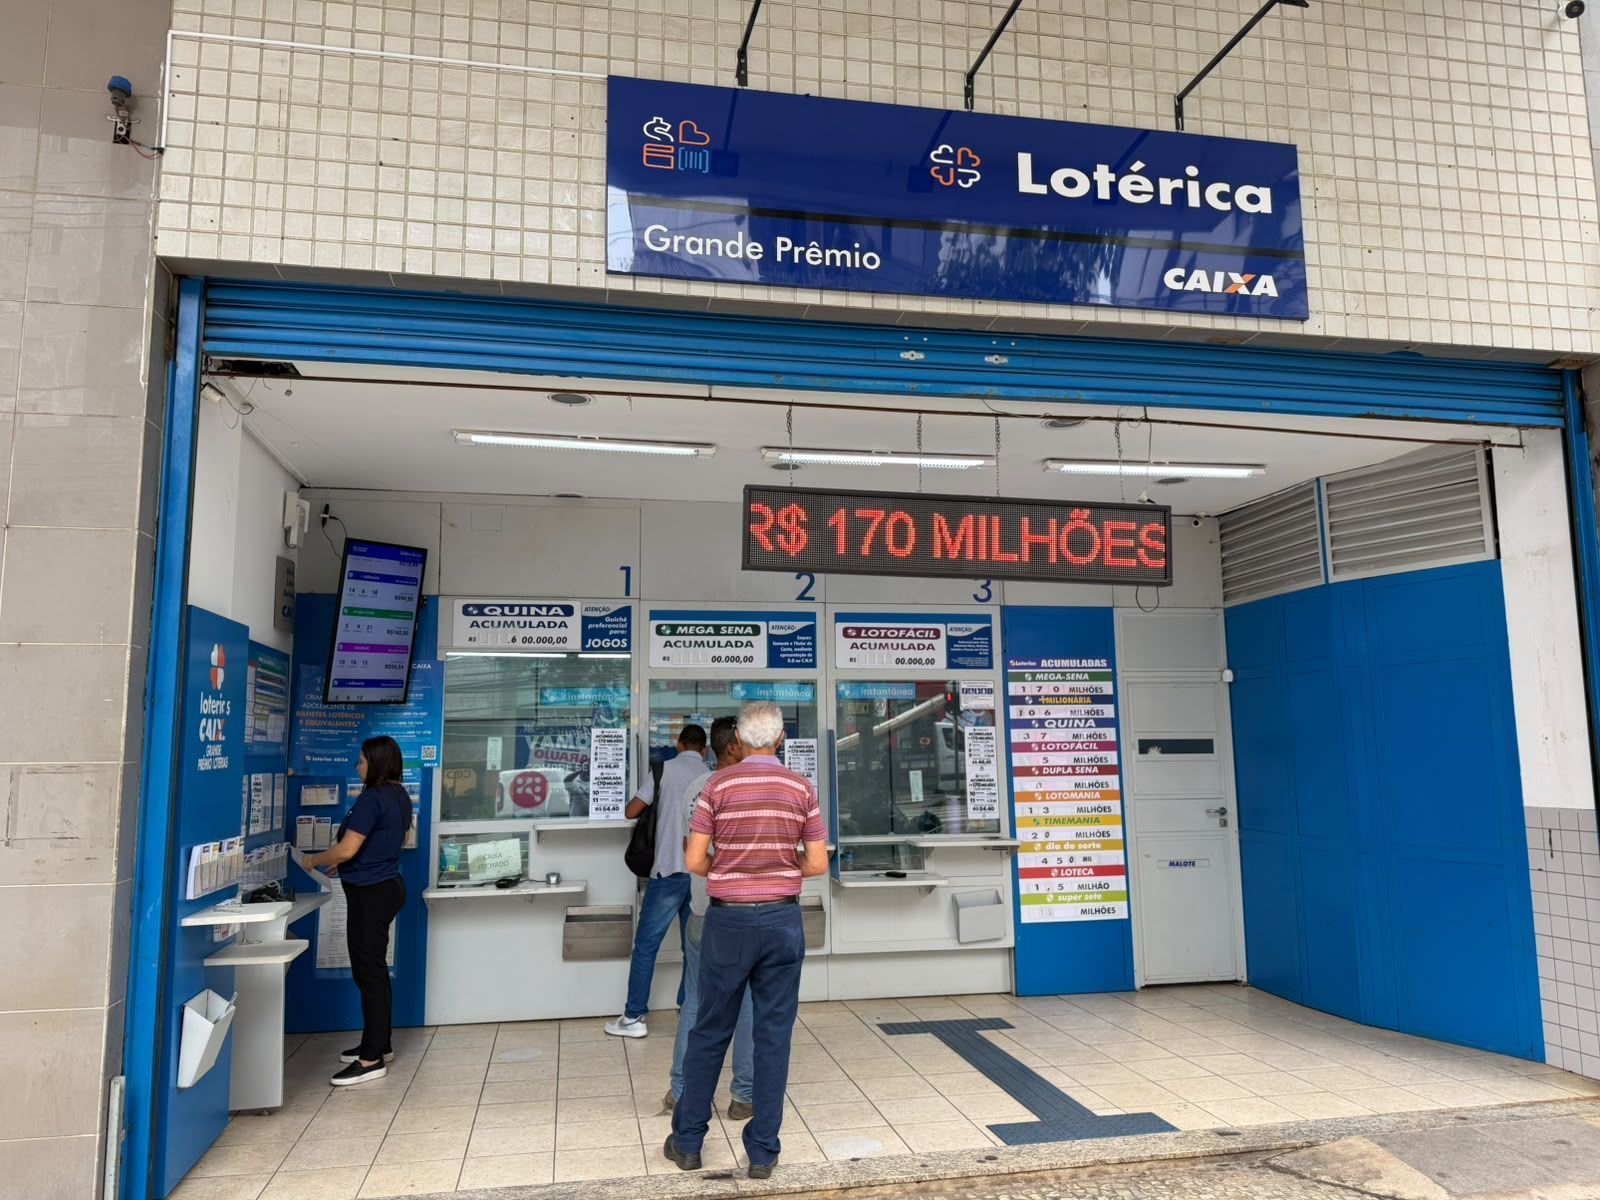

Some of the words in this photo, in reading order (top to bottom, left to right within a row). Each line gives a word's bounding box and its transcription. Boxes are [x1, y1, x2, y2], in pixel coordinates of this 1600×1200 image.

[1017, 152, 1272, 214] Lotérica
[643, 224, 763, 260] Grande
[776, 236, 881, 270] Prêmio
[1163, 267, 1278, 297] CAIXA
[750, 503, 808, 557] R$
[828, 507, 916, 557] 170
[933, 508, 1166, 568] MILHÕES
[619, 566, 631, 596] 1
[795, 572, 816, 601] 2
[973, 578, 992, 603] 3
[483, 606, 565, 617] QUINA
[469, 620, 568, 629] ACUMULADA
[588, 622, 628, 630] preferencial
[676, 626, 715, 634] MEGA
[719, 626, 754, 635] SENA
[861, 628, 936, 638] LOTOFÁCIL
[521, 636, 568, 646] 00.000,00
[585, 638, 627, 648] JOGOS
[663, 640, 755, 649] ACUMULADA
[850, 642, 936, 651] ACUMULADA
[711, 656, 754, 664] 00.000,00
[895, 657, 935, 666] 00.000,00
[1041, 659, 1107, 667] ACUMULADAS
[1035, 673, 1090, 681] MEGA-SENA
[1044, 719, 1096, 729] QUINA
[1041, 742, 1098, 751] LOTOFÁCIL
[1073, 756, 1109, 764] MILHÕES
[1074, 781, 1110, 789] MILHÕES
[1045, 791, 1100, 800] LOTOMANIA
[1043, 817, 1100, 825] TIMEMANIA
[1045, 842, 1061, 850] dia
[1060, 868, 1094, 876] LOTECA
[1077, 882, 1110, 890] MILHÃO
[1058, 895, 1081, 903] super
[1080, 907, 1116, 915] MILHÕES
